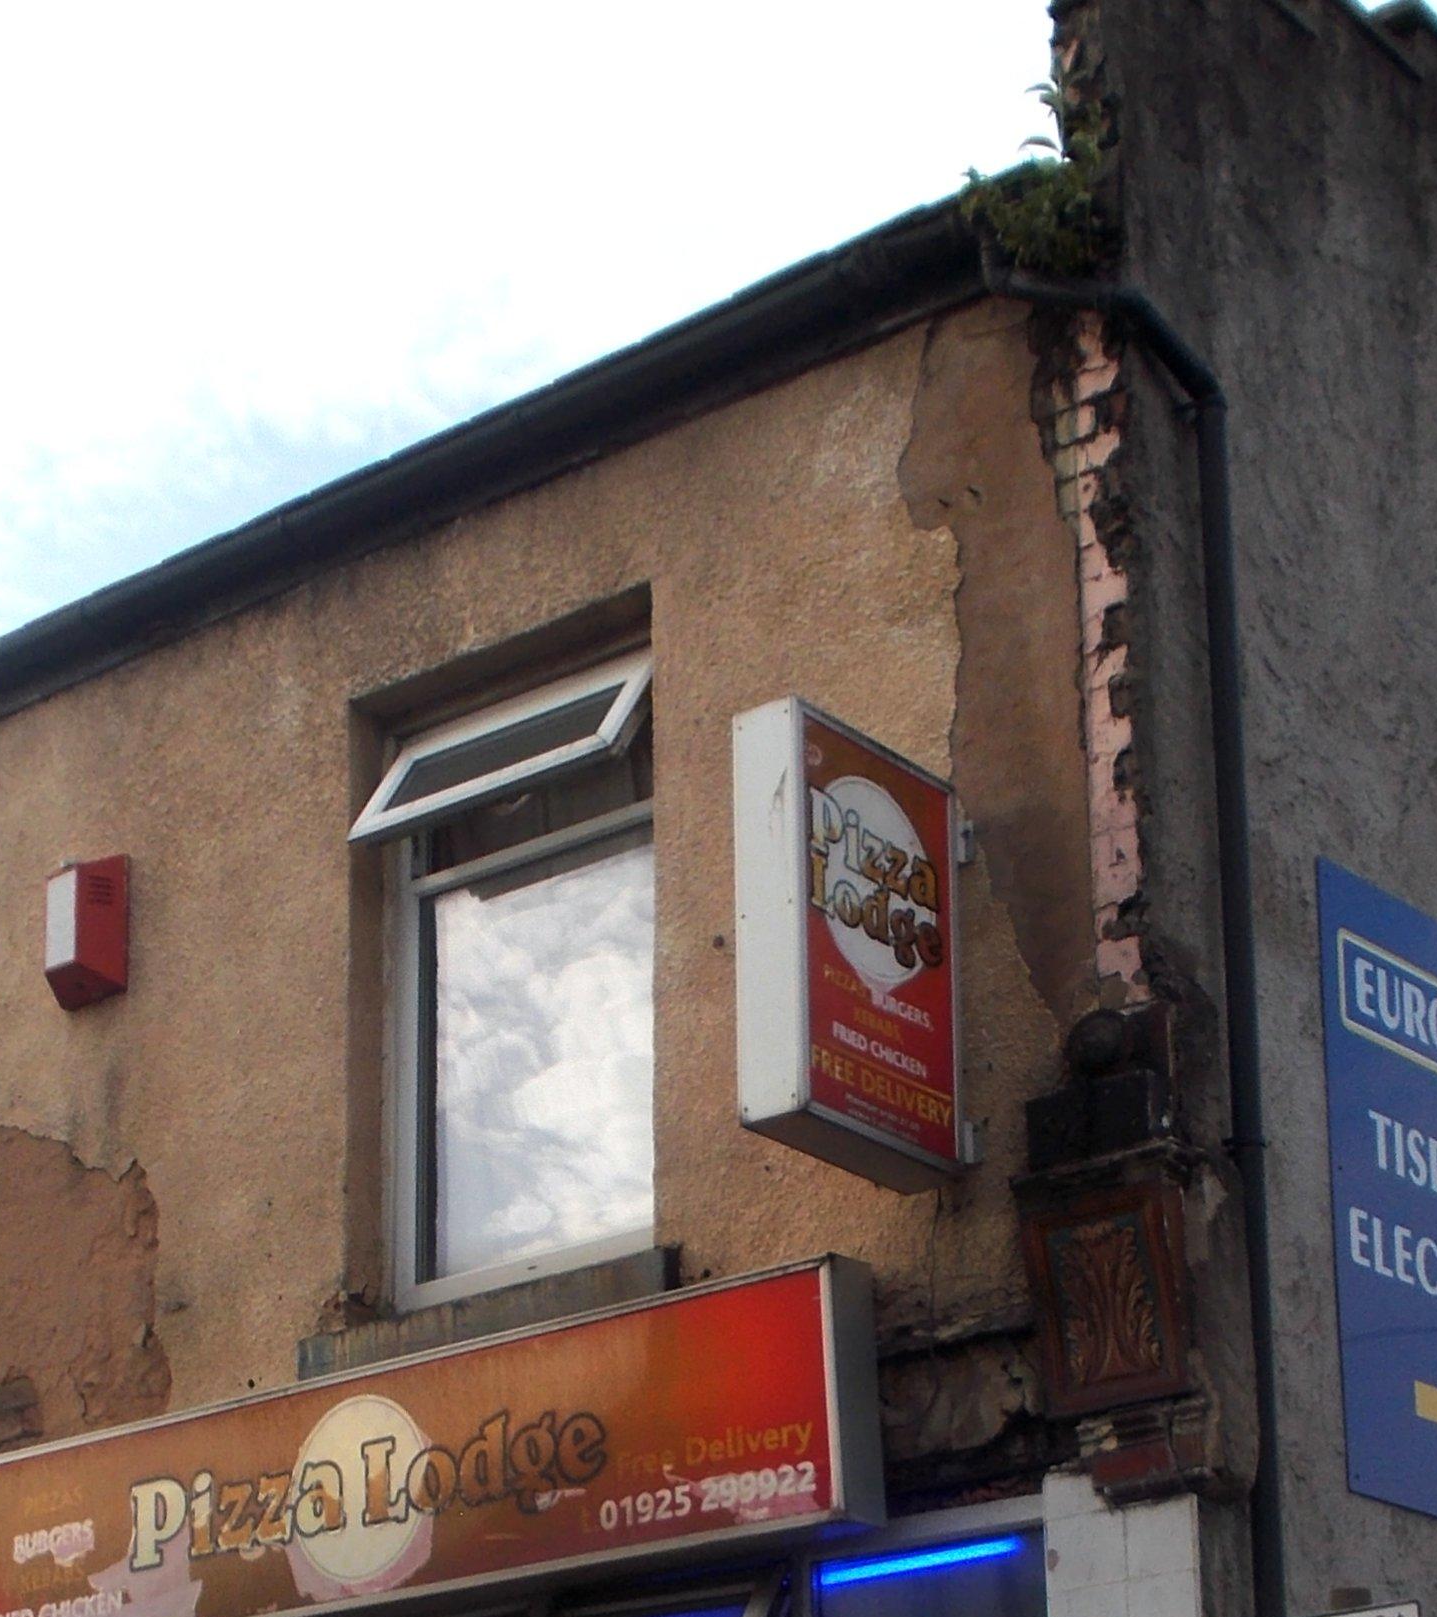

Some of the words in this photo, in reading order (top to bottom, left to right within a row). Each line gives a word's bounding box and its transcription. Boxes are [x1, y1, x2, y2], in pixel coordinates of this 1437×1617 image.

[809, 783, 939, 913] Pizza
[810, 848, 943, 969] Lodge
[811, 1044, 856, 1087] FREE
[861, 1067, 953, 1128] DELIVERY
[832, 1020, 869, 1054] FRIED
[870, 1040, 929, 1078] CHICKEN
[684, 1419, 813, 1467] Delivery
[128, 1459, 347, 1573] Pizza
[360, 1408, 609, 1530] Lodge
[599, 1484, 692, 1531] 01925
[700, 1460, 817, 1513] 299922
[13, 1519, 96, 1564] BURGERS
